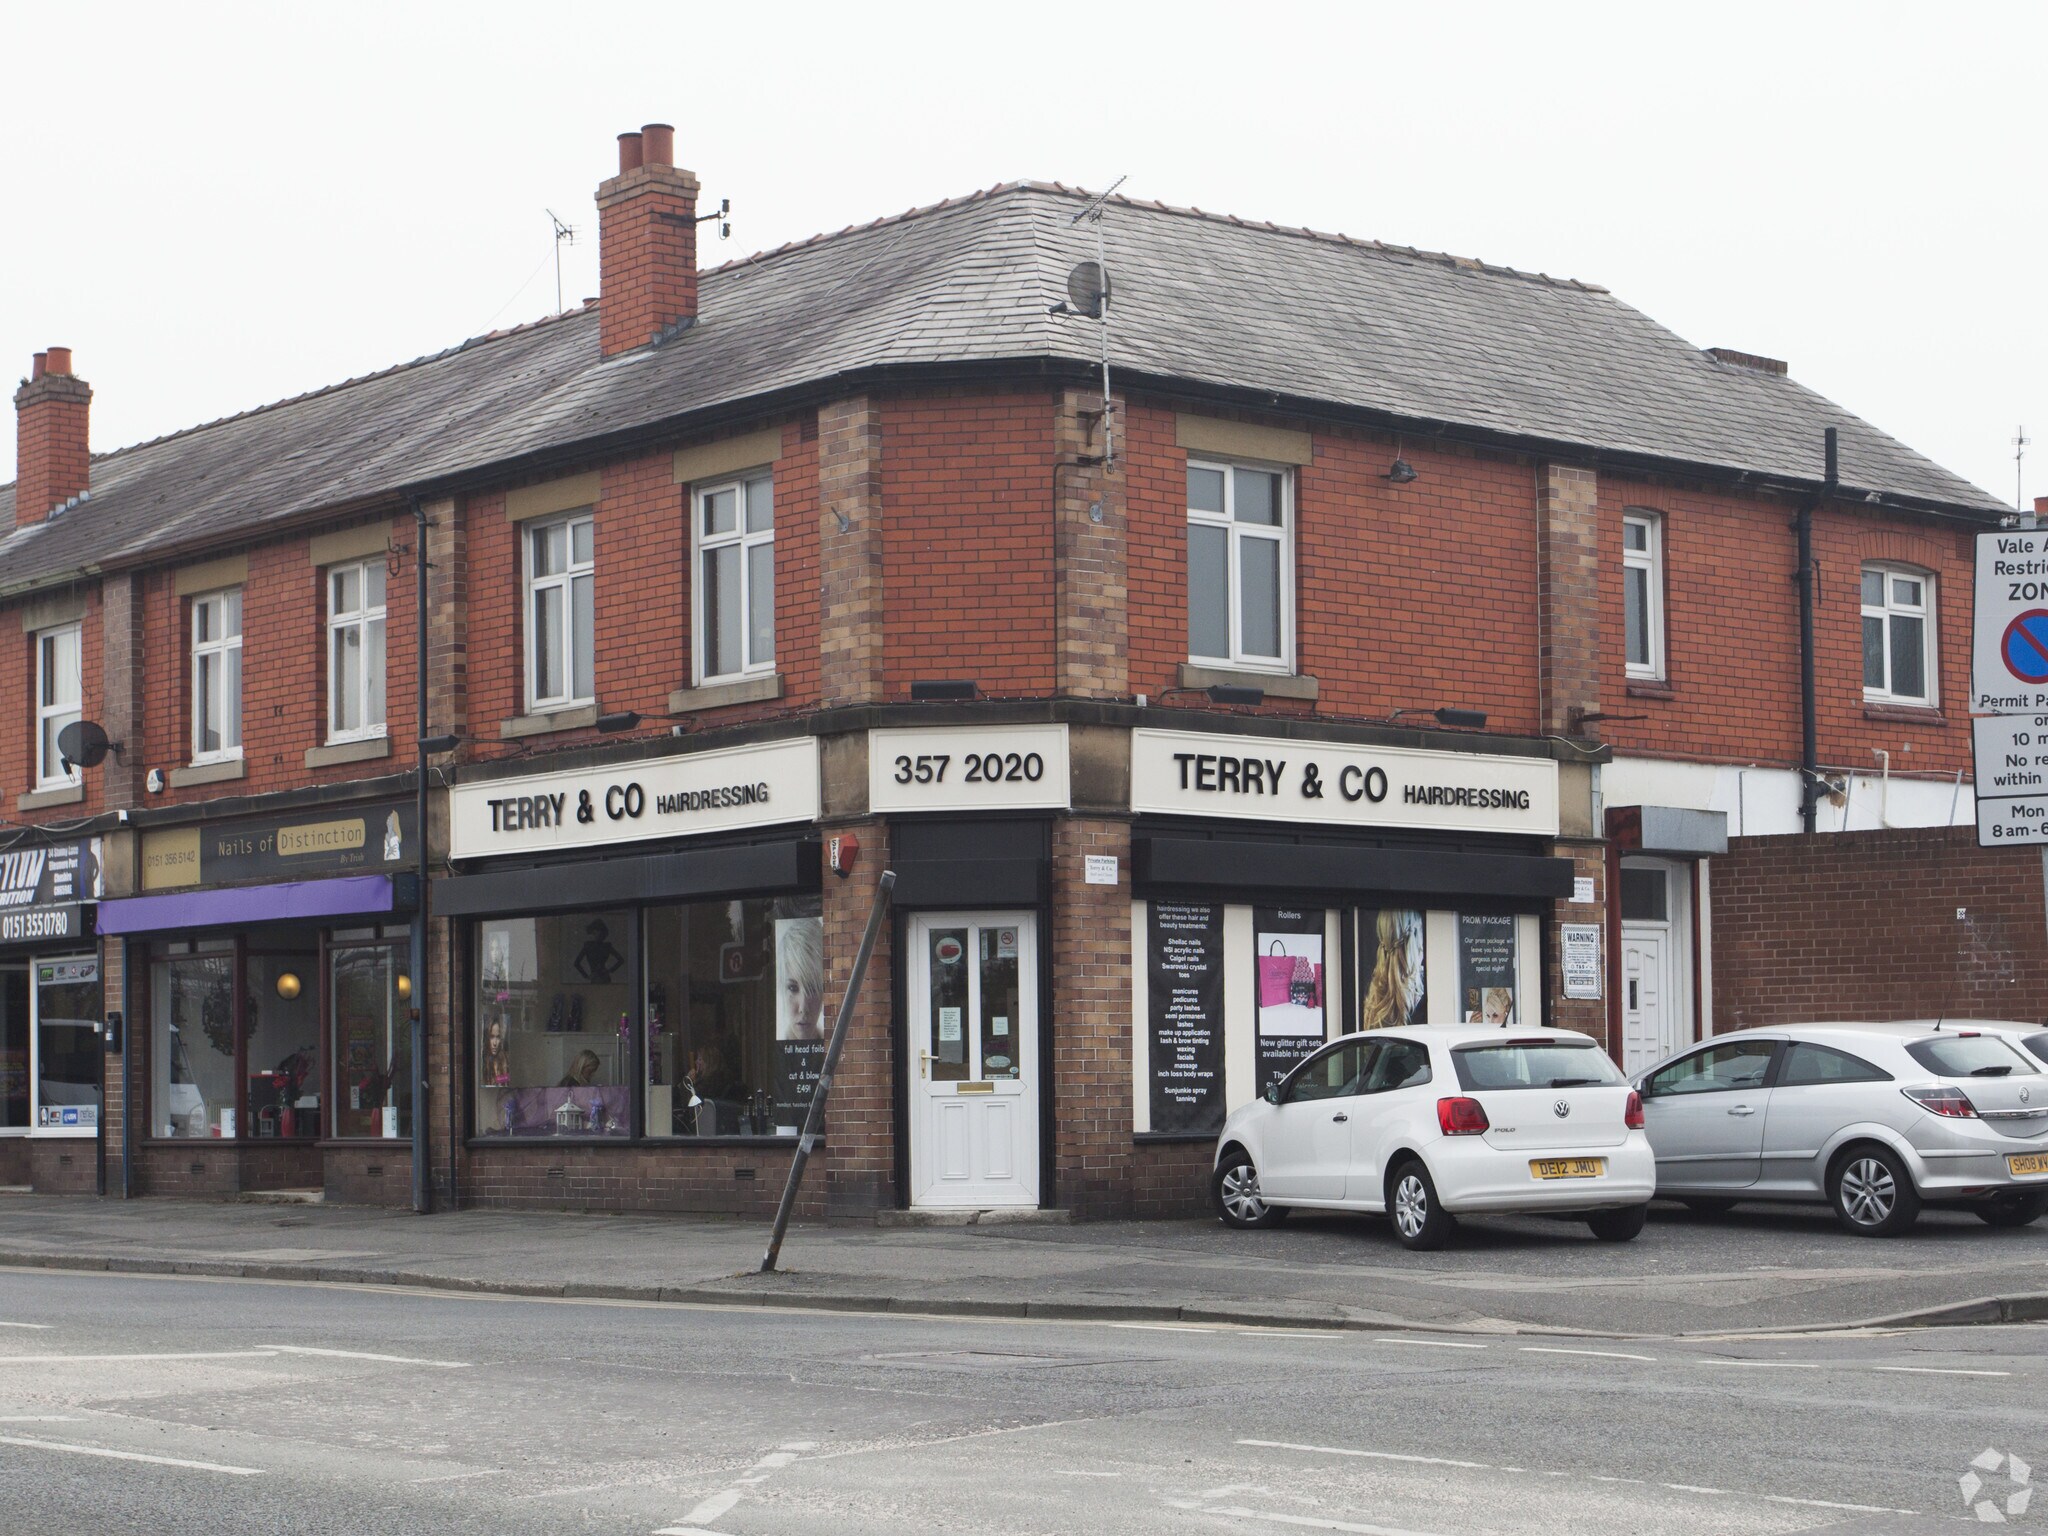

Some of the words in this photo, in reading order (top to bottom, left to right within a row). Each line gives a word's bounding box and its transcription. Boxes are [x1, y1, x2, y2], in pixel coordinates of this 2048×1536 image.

[1997, 538, 2034, 554] Vale
[1995, 559, 2048, 576] Restri
[1981, 694, 2028, 707] Permit
[2036, 694, 2048, 706] P
[2012, 732, 2030, 746] 10
[2006, 754, 2027, 767] No
[894, 755, 950, 784] 357
[964, 752, 1044, 782] 2020
[1174, 753, 1286, 796] TERRY
[1301, 762, 1324, 800] &
[1340, 765, 1388, 802] CO
[1404, 784, 1530, 810] HAIRDRESSING
[1994, 772, 2042, 786] within
[487, 792, 565, 832] TERRY
[576, 789, 594, 824] &
[605, 782, 644, 820] CO
[656, 782, 768, 814] HAIRDRESSING
[2012, 805, 2044, 818] Mon
[218, 838, 252, 856] Nails
[259, 836, 273, 852] of
[281, 826, 362, 850] Distinction
[148, 855, 162, 868] 0151
[1278, 911, 1301, 919] Rollers
[1462, 916, 1480, 924] PROM
[1482, 916, 1511, 925] PACKAGE
[1567, 932, 1594, 942] WARNING
[784, 1045, 793, 1054] full
[795, 1045, 809, 1053] head
[812, 1044, 825, 1053] foils
[1277, 1039, 1295, 1048] glitter
[1297, 1039, 1307, 1048] gift
[801, 1058, 806, 1066] &
[1540, 1162, 1569, 1175] DE12
[1573, 1161, 1596, 1173] JMU
[2014, 1156, 2036, 1171] SH08
